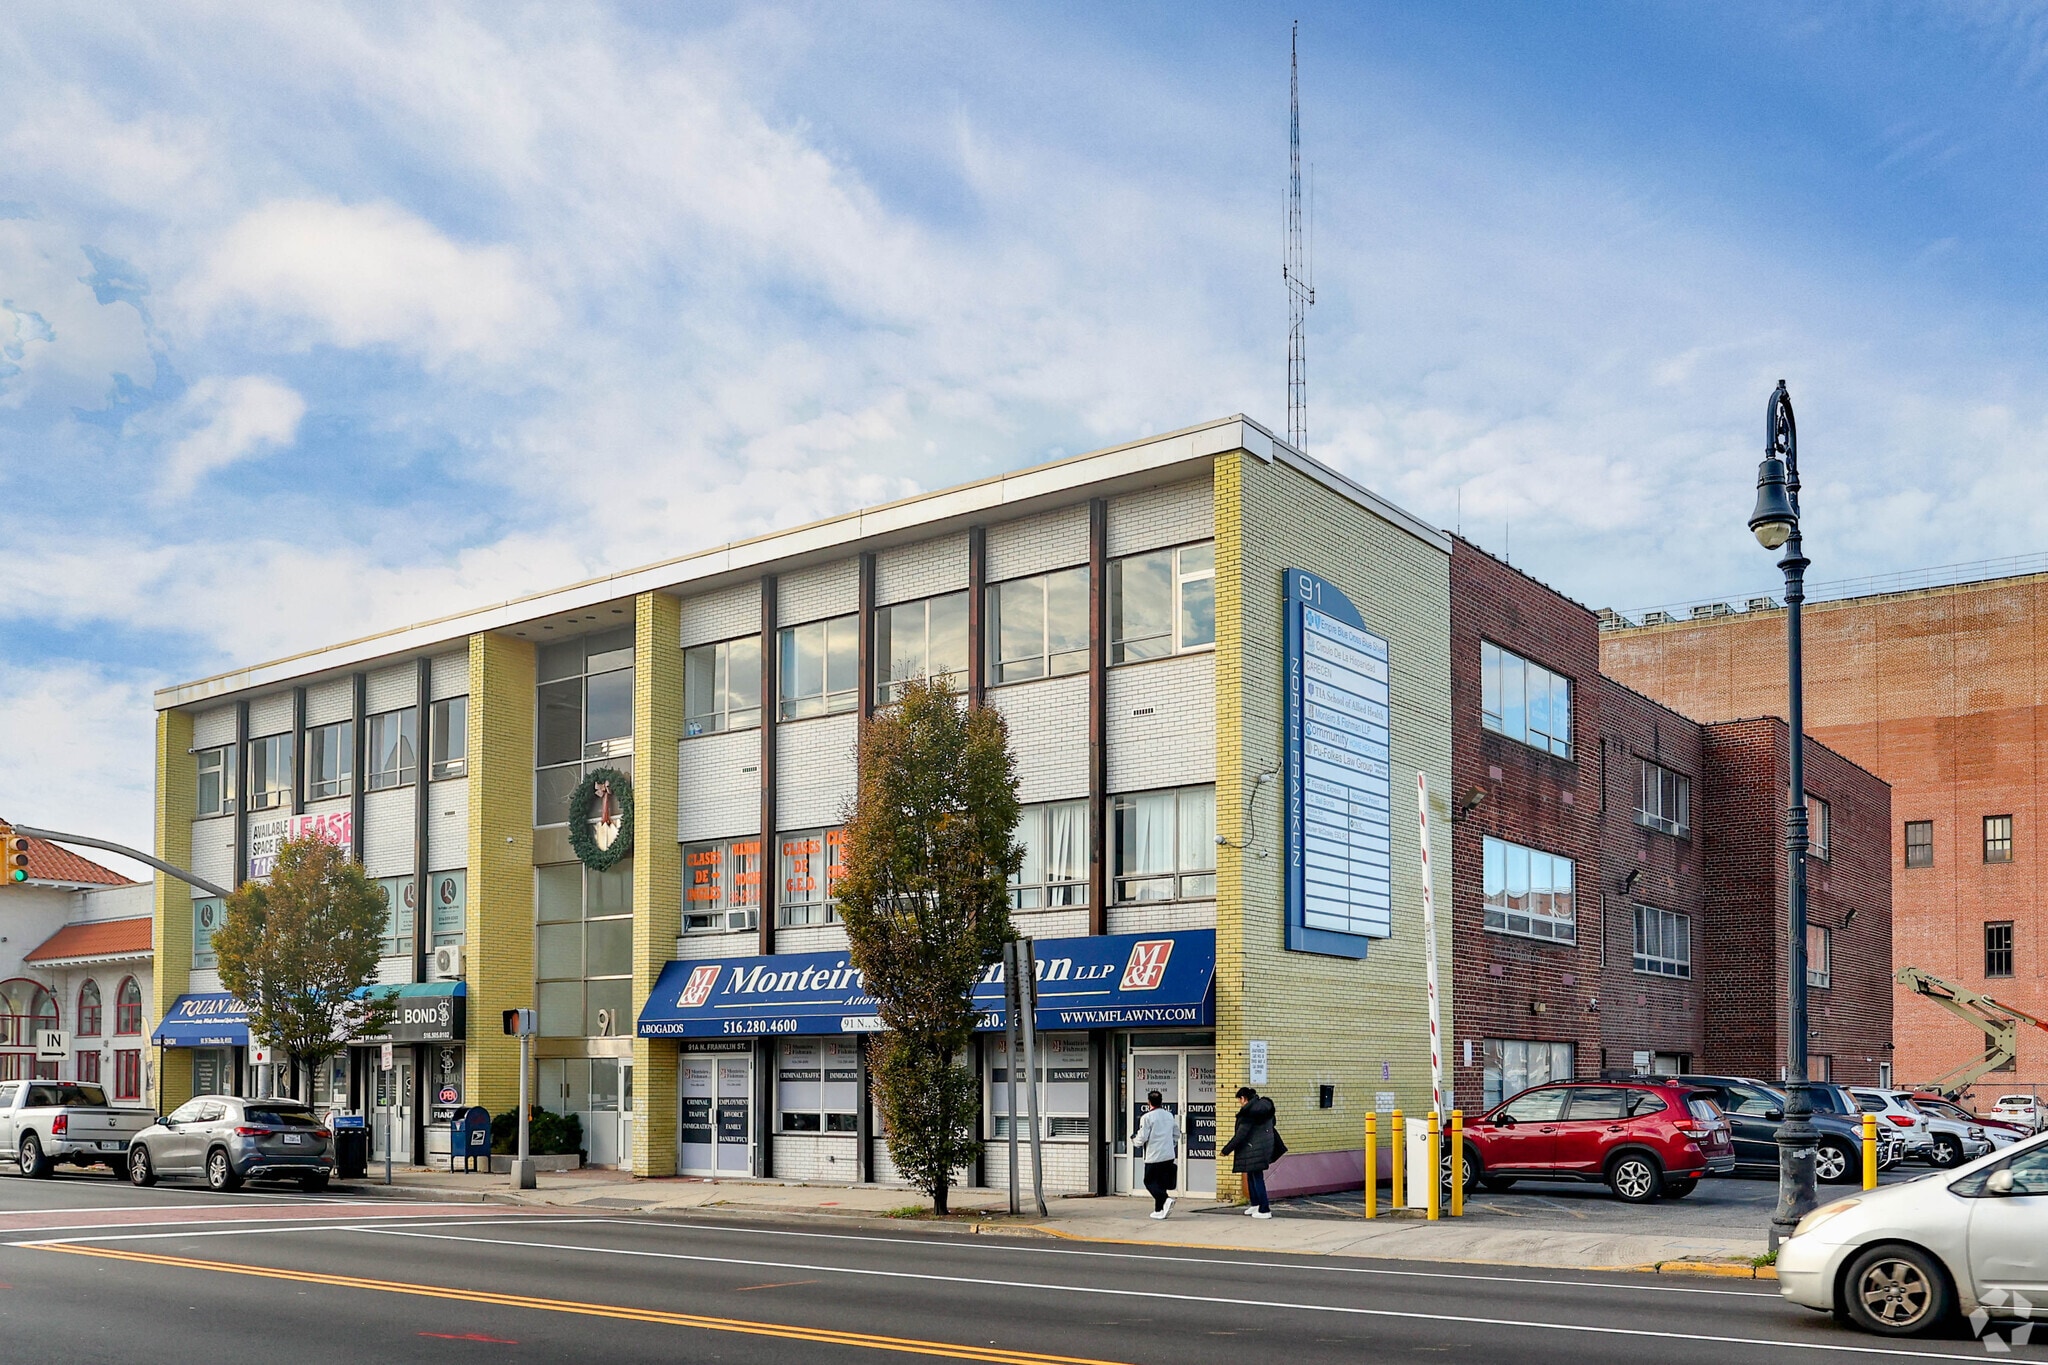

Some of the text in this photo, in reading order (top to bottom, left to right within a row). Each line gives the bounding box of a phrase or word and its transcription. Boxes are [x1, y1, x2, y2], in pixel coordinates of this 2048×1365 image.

[1299, 574, 1321, 605] 91
[1327, 692, 1345, 706] School
[1345, 698, 1351, 709] of
[1305, 721, 1349, 749] Community
[1292, 657, 1301, 867] NORTH FRANKLIN
[1343, 753, 1356, 767] Law
[1356, 758, 1374, 773] Group
[253, 820, 288, 839] AVAILABLE
[289, 812, 351, 847] LEASE
[253, 840, 274, 855] SPACE
[783, 840, 821, 857] CLASES
[687, 850, 722, 867] CLASES
[793, 859, 808, 873] DE
[695, 869, 709, 884] DE
[1073, 964, 1115, 980] LLP
[404, 1008, 437, 1024] BOND
[597, 1008, 616, 1037] 91
[843, 1018, 854, 1028] 91
[1060, 1008, 1197, 1024] WWW.MFLAWNY.COM
[640, 1023, 684, 1034] ABOGADOS
[723, 1019, 798, 1034] 516.280.4600
[47, 1033, 61, 1048] IN
[688, 1043, 699, 1051] 91A
[707, 1043, 736, 1051] FRANKLIN
[737, 1042, 746, 1050] ST.
[1053, 1071, 1089, 1079] BANKRUPTC
[1188, 1104, 1216, 1113] EMPLOY
[1196, 1120, 1216, 1128] DIVOR
[718, 1135, 749, 1143] BANKRUPTCY
[1189, 1149, 1216, 1158] BANKRU
